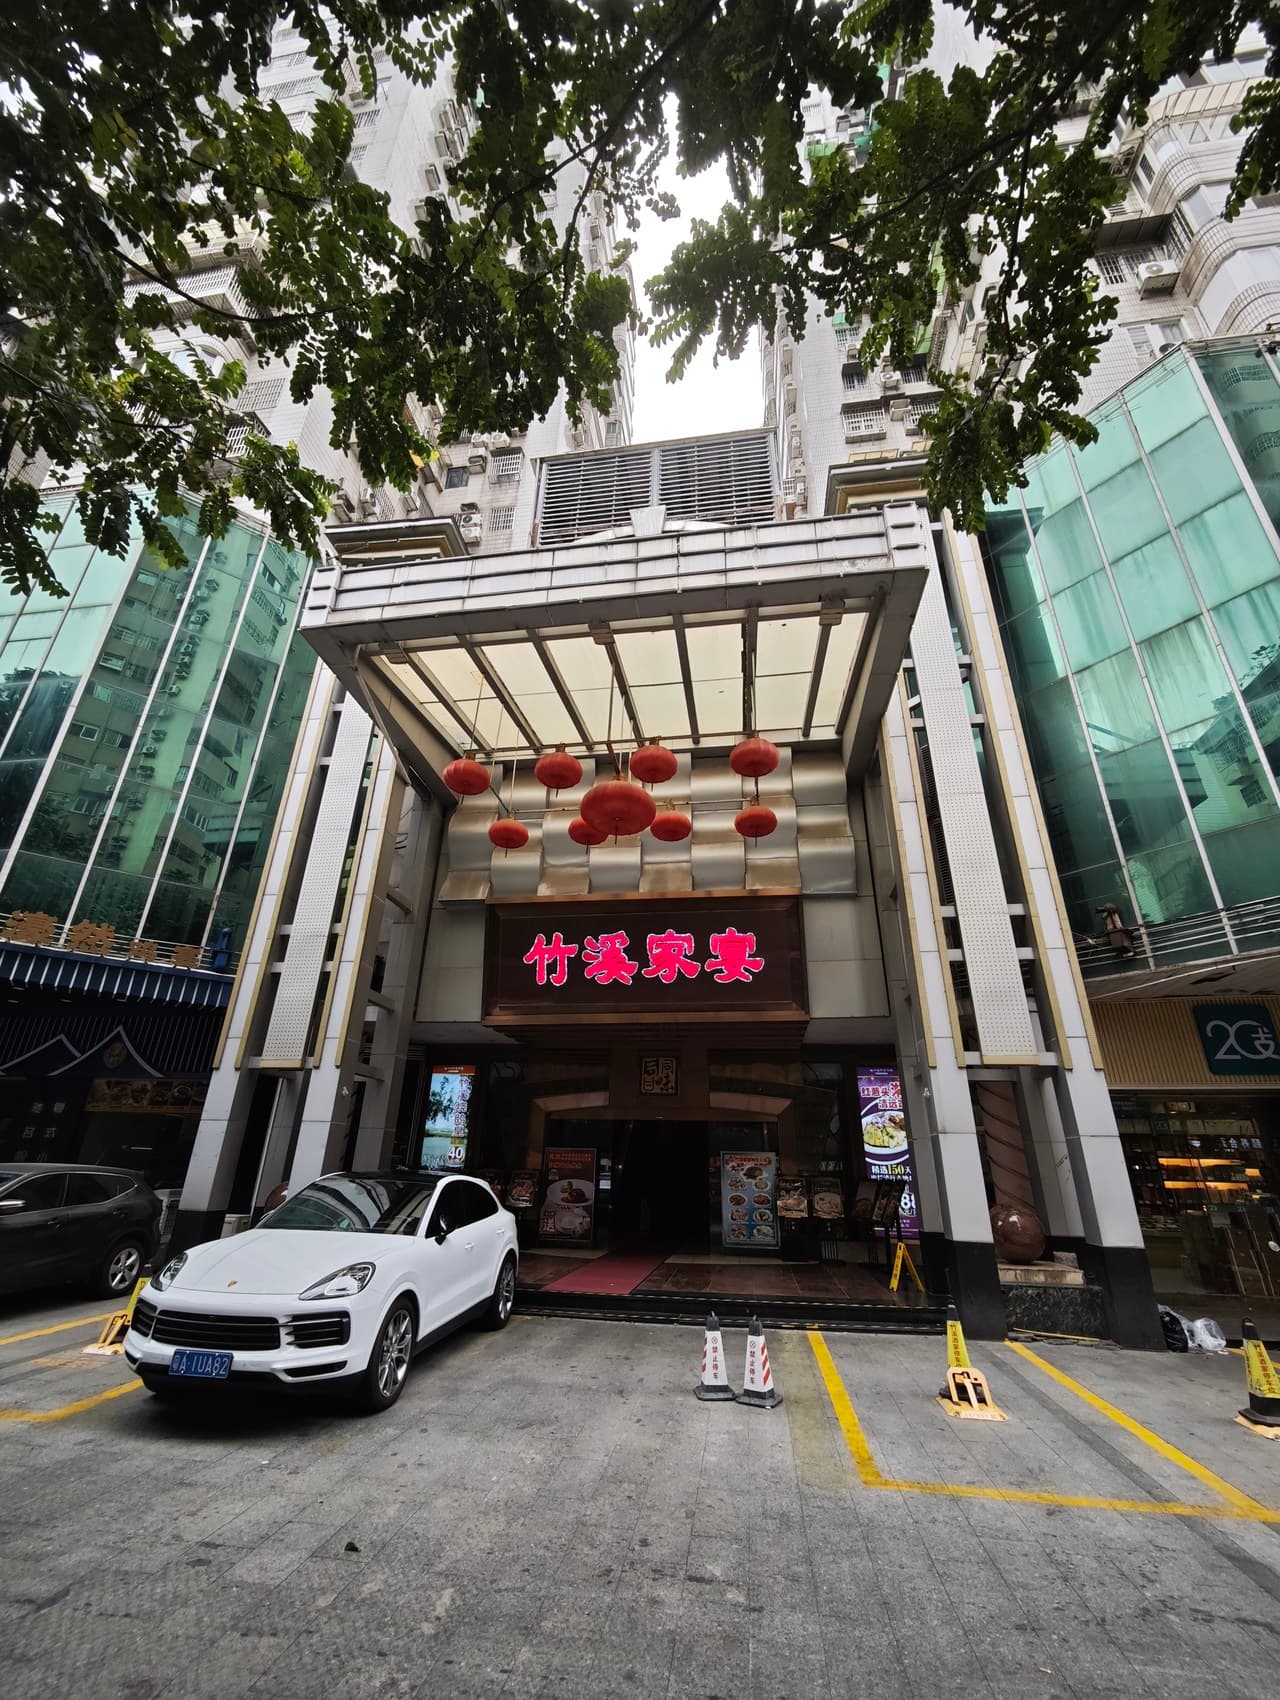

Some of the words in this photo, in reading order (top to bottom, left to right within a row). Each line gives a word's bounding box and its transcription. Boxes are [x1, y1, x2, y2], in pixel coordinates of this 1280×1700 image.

[523, 927, 765, 986] 竹溪家宴
[448, 1146, 463, 1159] 40
